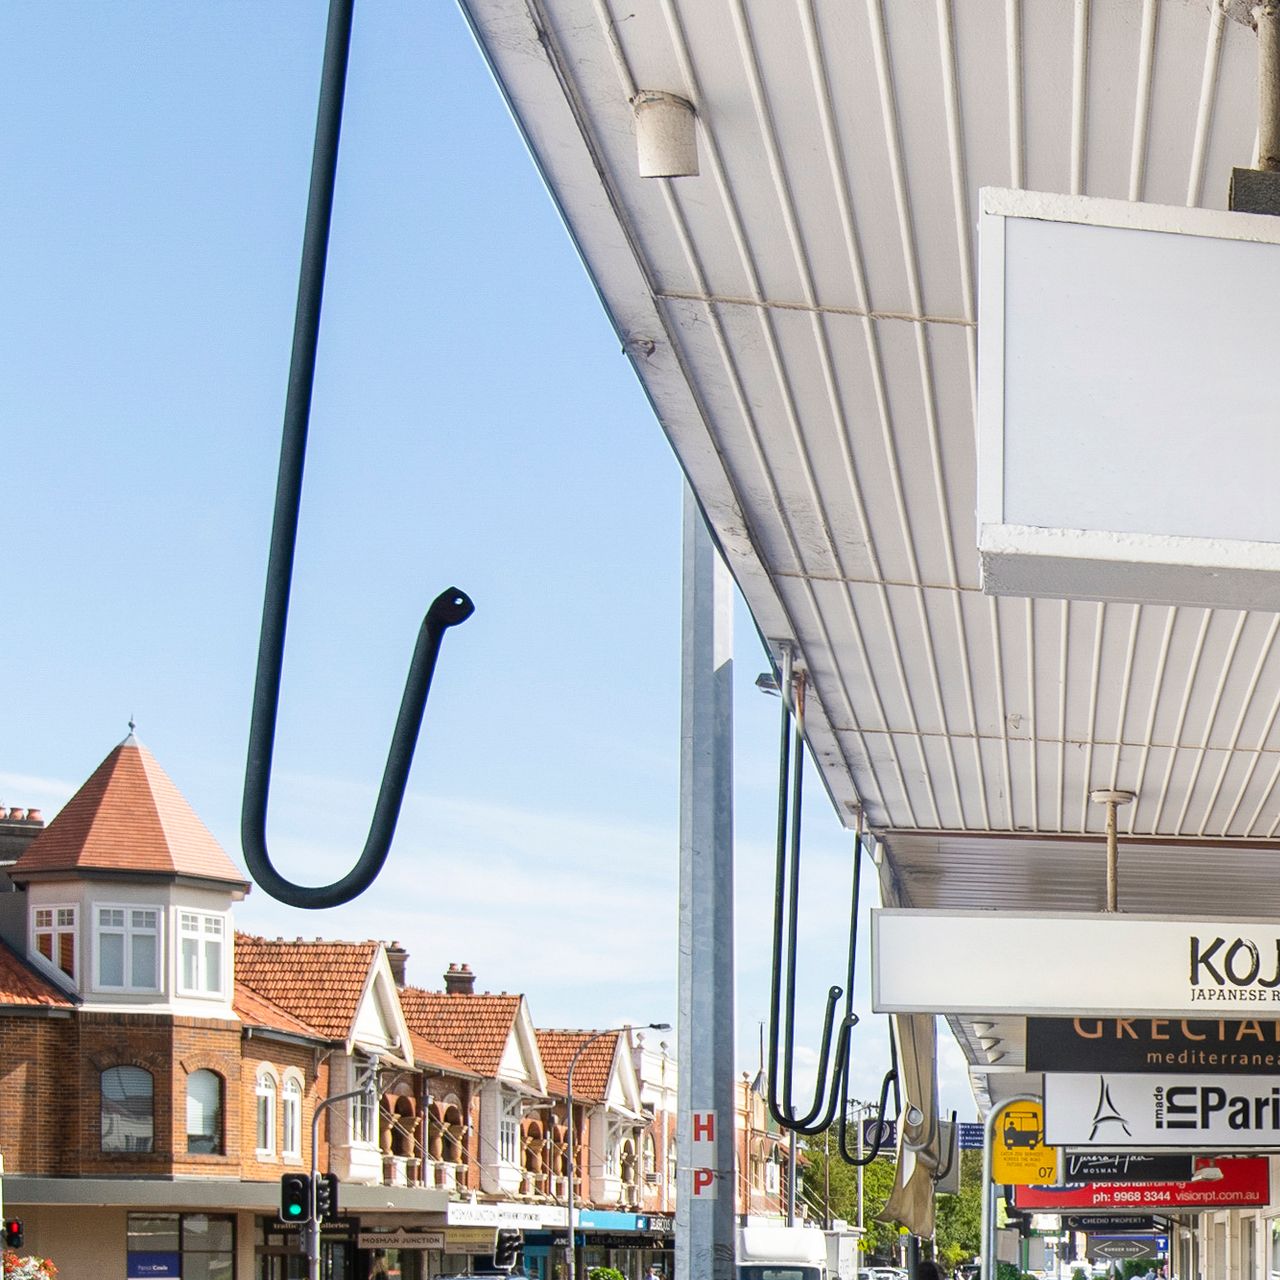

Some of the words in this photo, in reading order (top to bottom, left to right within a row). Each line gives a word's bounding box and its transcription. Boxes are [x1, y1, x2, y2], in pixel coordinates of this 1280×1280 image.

[1191, 988, 1267, 1002] JAPANESE
[1154, 1086, 1164, 1120] made
[693, 1113, 715, 1142] H
[1038, 1167, 1054, 1178] 07
[693, 1167, 714, 1196] P
[1092, 1192, 1111, 1204] ph:
[1113, 1192, 1141, 1202] 9968
[1143, 1191, 1171, 1201] 3344
[1175, 1190, 1260, 1203] visionpt.com.au
[319, 1222, 350, 1230] alleries
